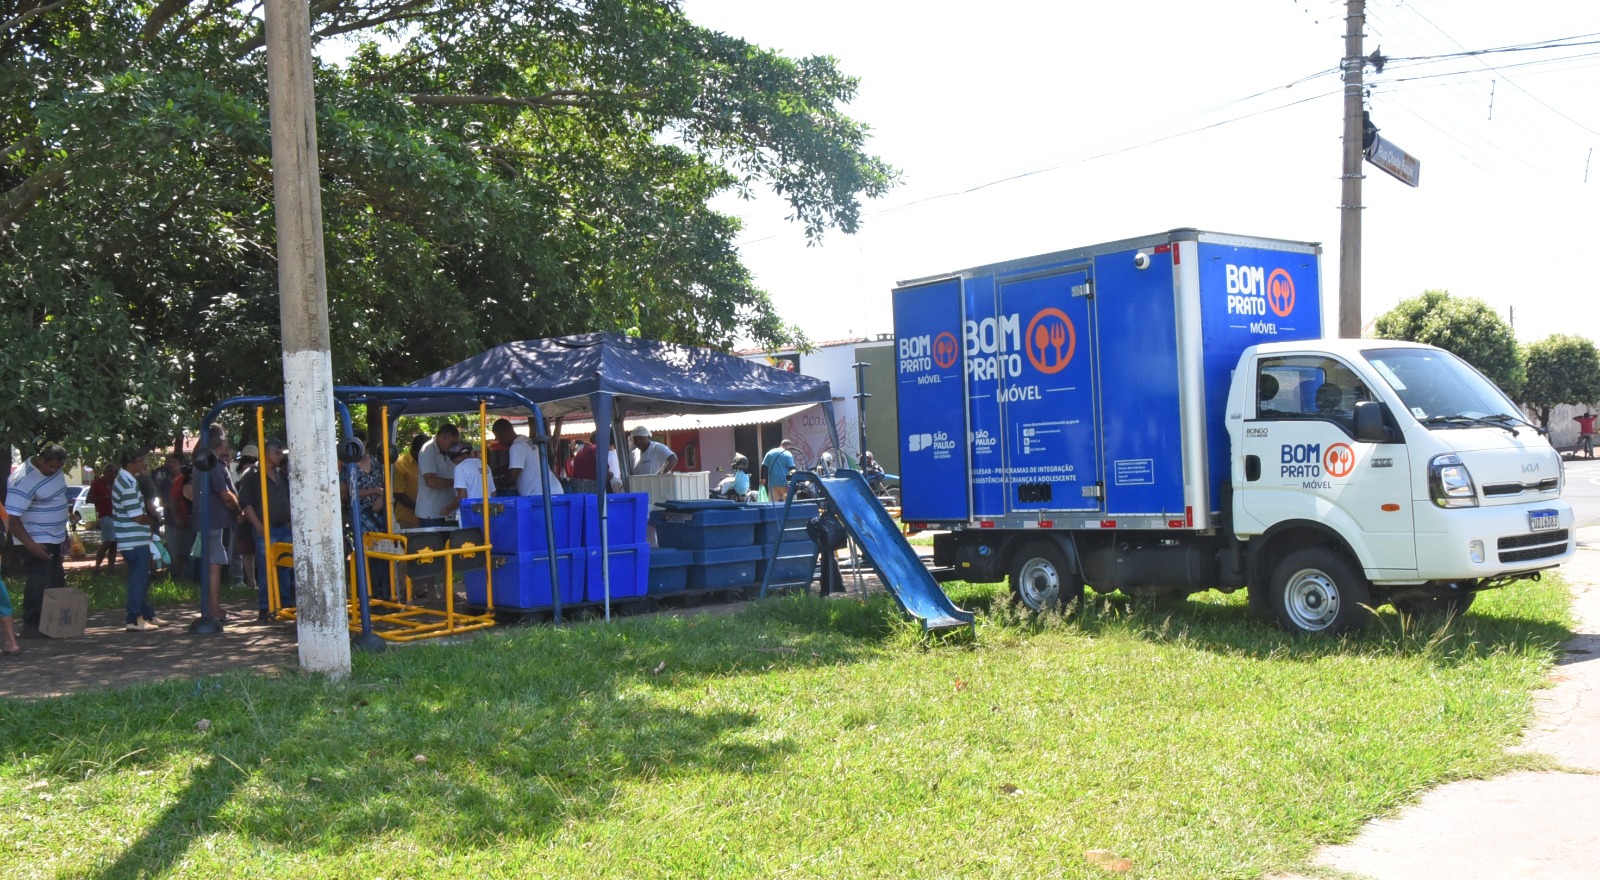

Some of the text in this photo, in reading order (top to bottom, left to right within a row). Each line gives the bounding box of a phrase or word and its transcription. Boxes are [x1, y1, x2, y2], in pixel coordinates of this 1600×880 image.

[1226, 264, 1265, 296] BOM
[1228, 295, 1266, 316] PRATO
[1250, 320, 1278, 334] MÓVEL
[966, 313, 1020, 356] BOM
[900, 334, 931, 359] BOM
[900, 357, 932, 374] PRATO
[966, 354, 1022, 382] PRATO
[918, 374, 942, 384] MÓVEL
[996, 384, 1042, 402] MÓVEL
[934, 430, 948, 441] SÃO
[975, 429, 989, 438] SÃO
[934, 440, 955, 450] PAULO
[975, 438, 996, 446] PAULO
[1280, 443, 1320, 464] BOM
[995, 466, 1029, 474] PROGRAMAS
[1038, 464, 1074, 473] INTEGRAÇÃO
[1281, 464, 1320, 478] PRATO
[1302, 480, 1332, 489] MÓVEL
